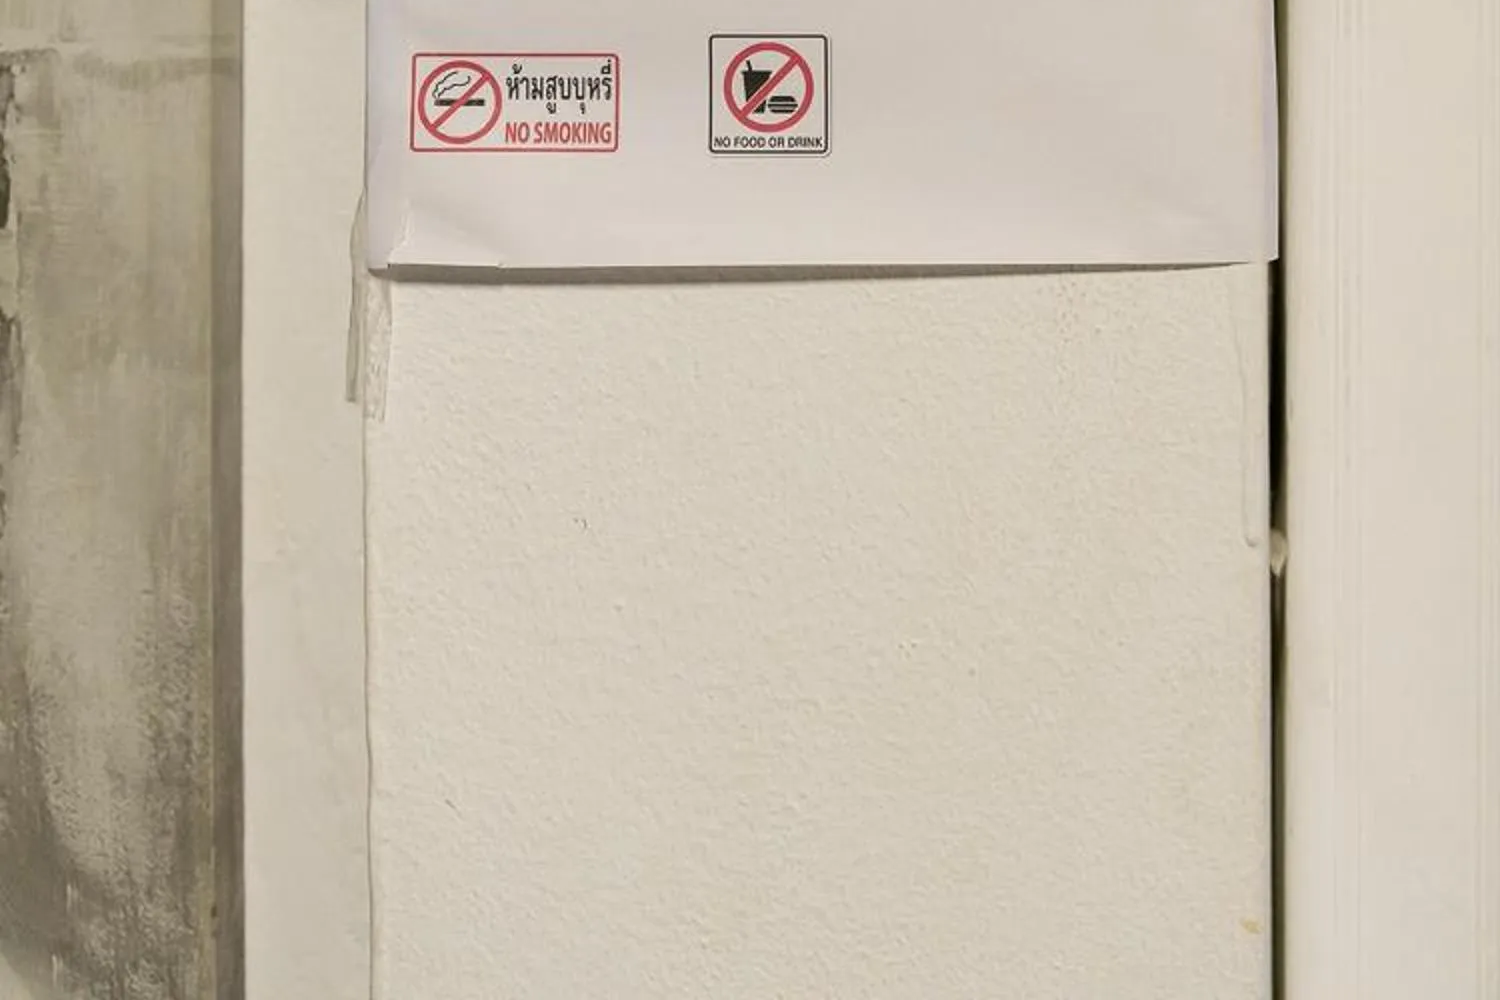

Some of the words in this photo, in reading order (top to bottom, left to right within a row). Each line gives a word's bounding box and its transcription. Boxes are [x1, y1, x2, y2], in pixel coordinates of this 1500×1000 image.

[505, 60, 612, 114] ห้ามสูบบุหรี่
[504, 122, 530, 144] NO
[533, 121, 612, 145] SMOKING
[714, 136, 731, 148] NO
[733, 136, 766, 148] FOOD
[769, 136, 785, 148] OR
[788, 136, 823, 148] DRINK
